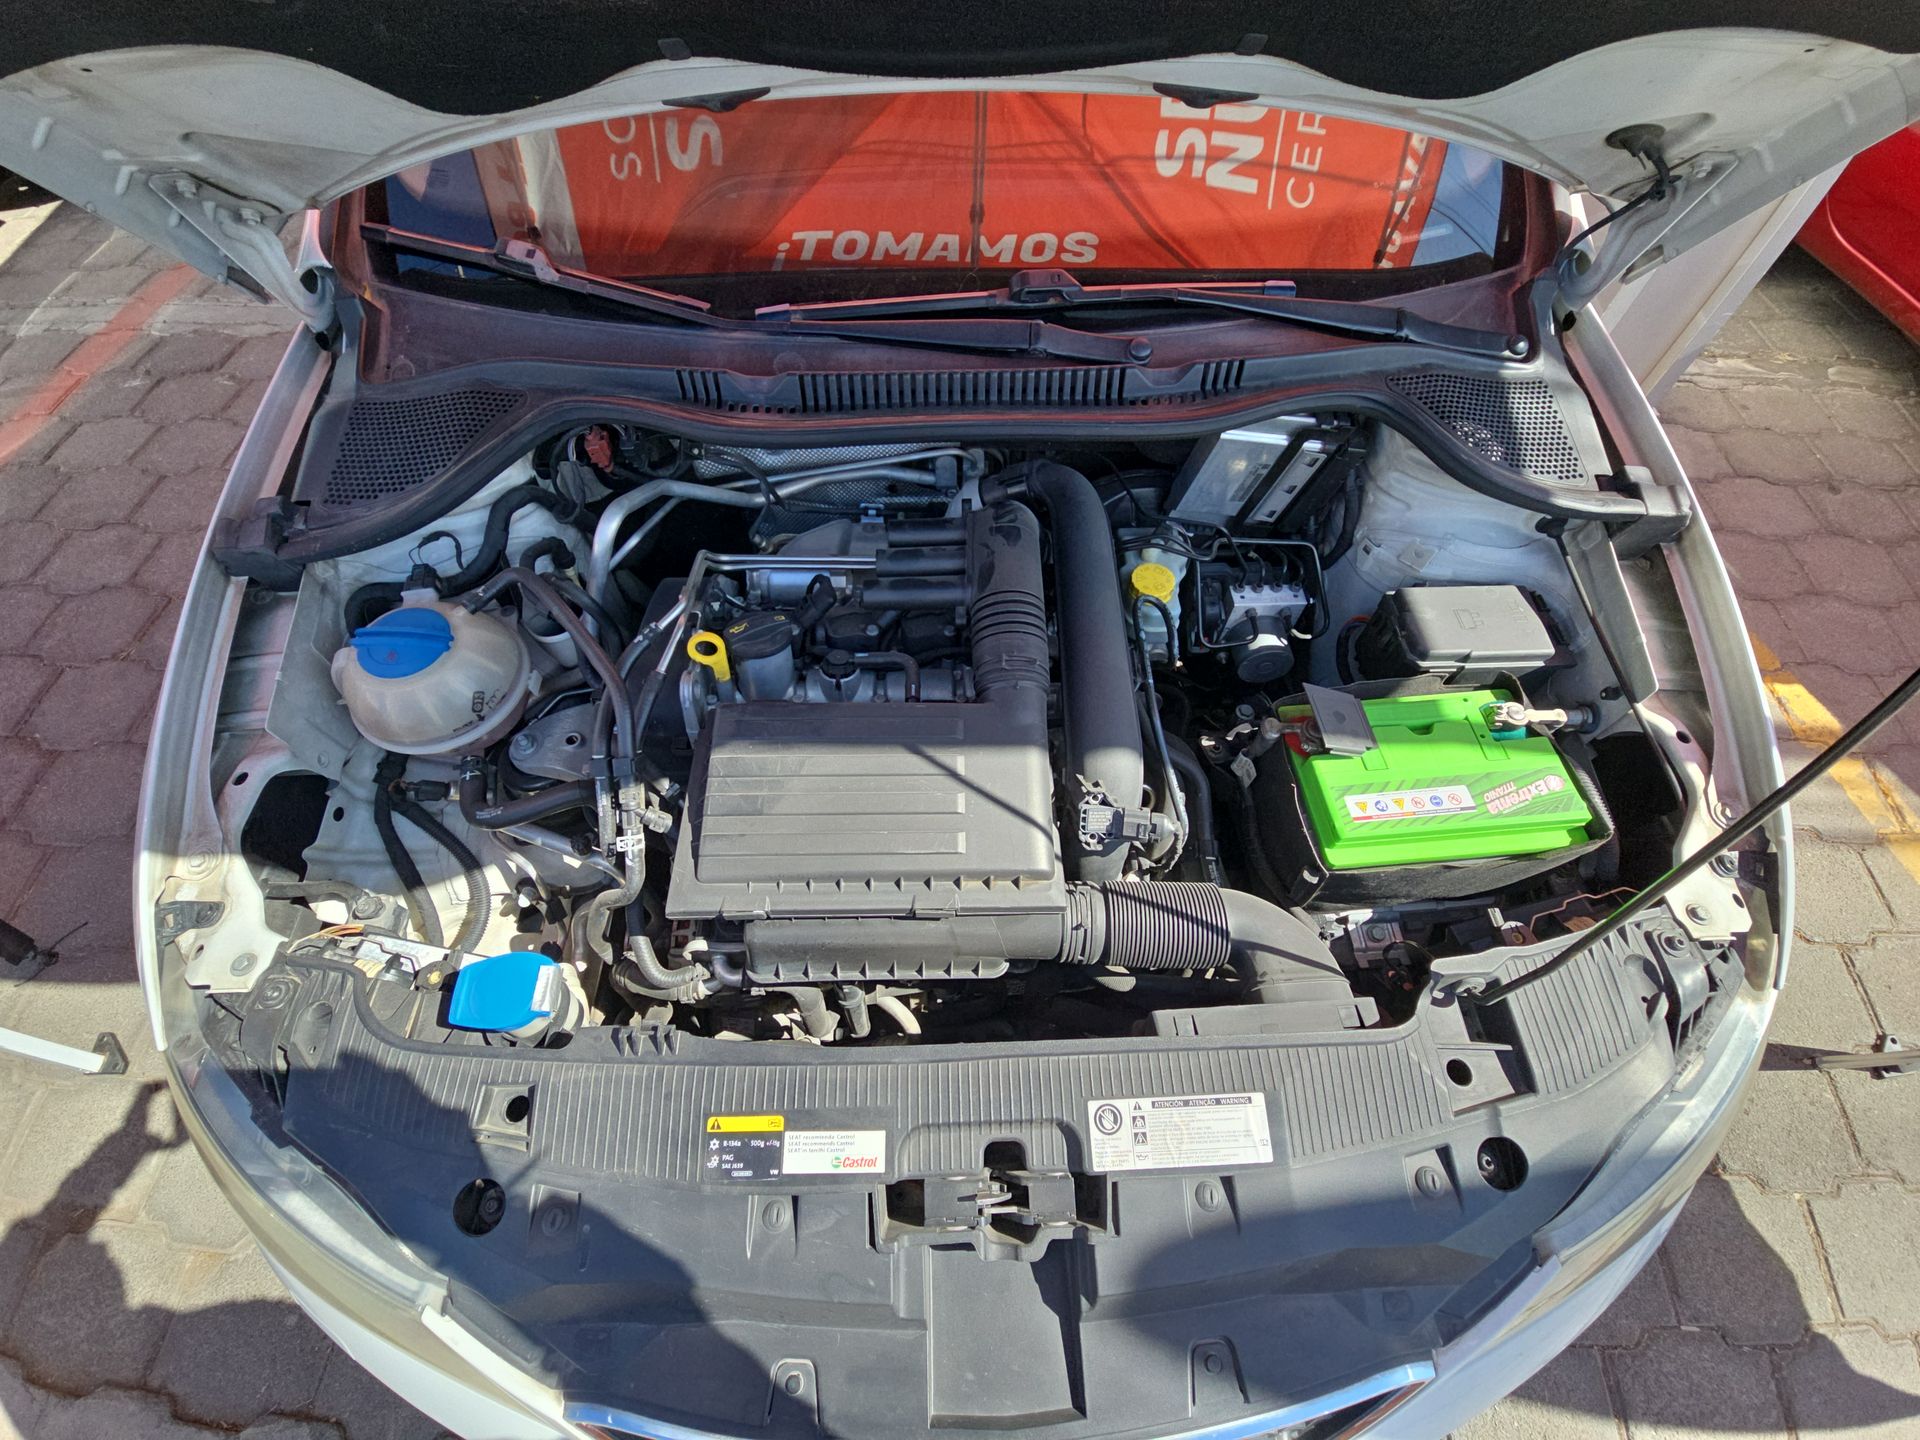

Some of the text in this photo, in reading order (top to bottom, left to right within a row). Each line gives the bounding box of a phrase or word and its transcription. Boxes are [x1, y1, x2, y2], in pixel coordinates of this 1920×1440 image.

[1154, 1097, 1249, 1108] ATENCIÓN ATENÇÃO WARNING
[842, 1156, 878, 1168] Castrol
